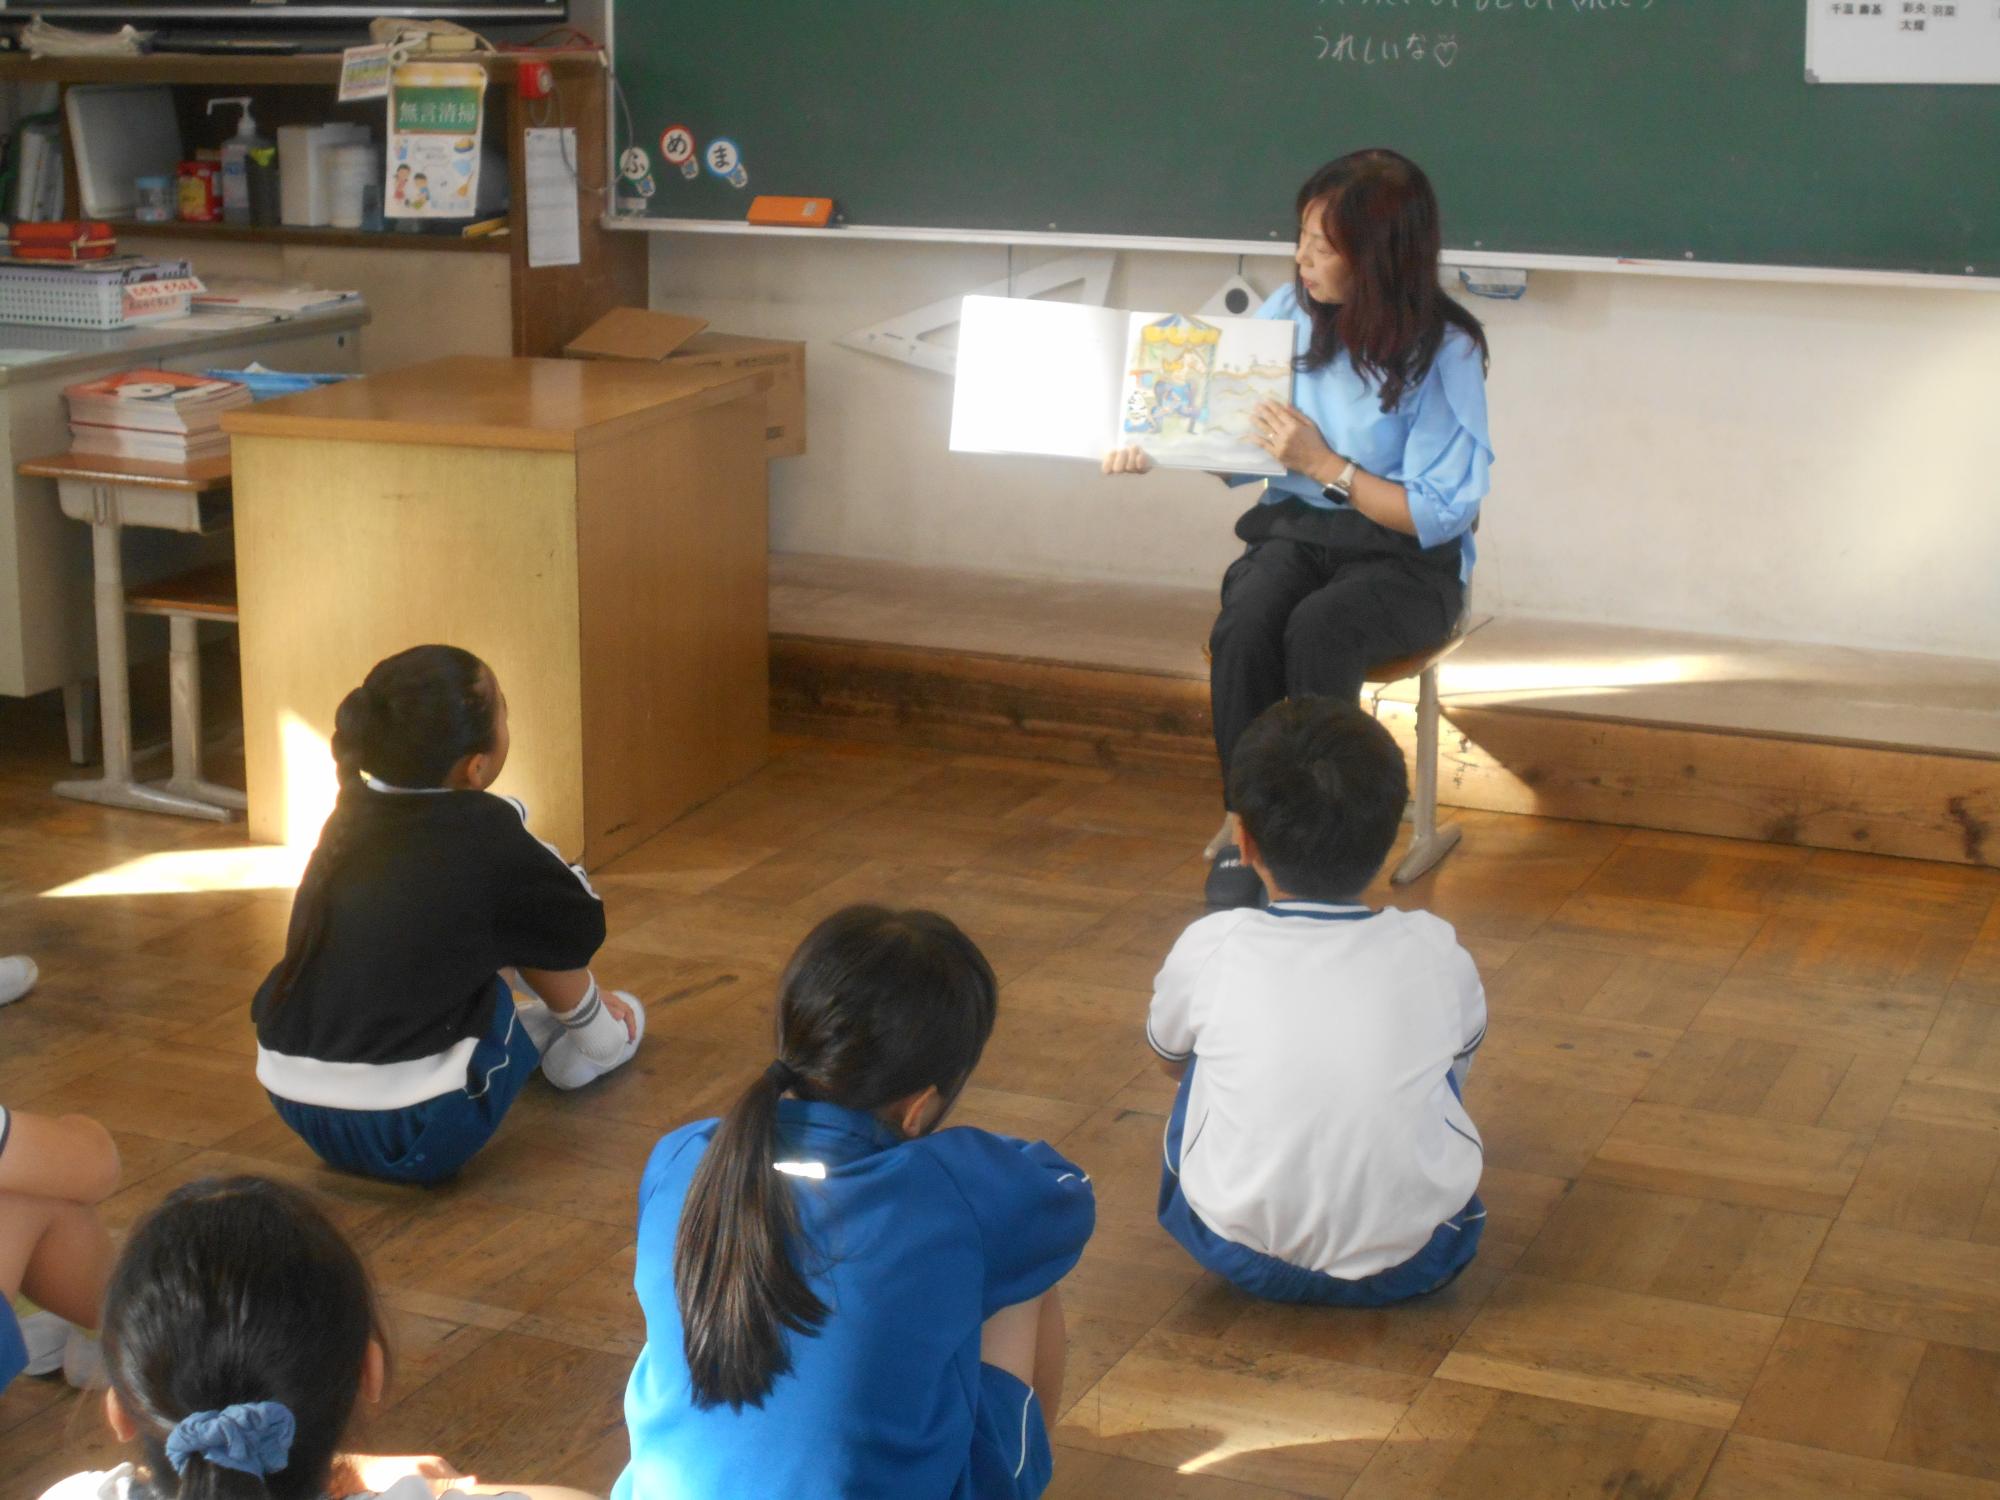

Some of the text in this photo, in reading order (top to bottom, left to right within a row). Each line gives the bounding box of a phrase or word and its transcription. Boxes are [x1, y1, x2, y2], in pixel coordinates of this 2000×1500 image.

[1313, 26, 1426, 64] うれしいな
[399, 101, 475, 123] 無言清掃
[666, 134, 687, 155] め
[713, 145, 730, 169] ま
